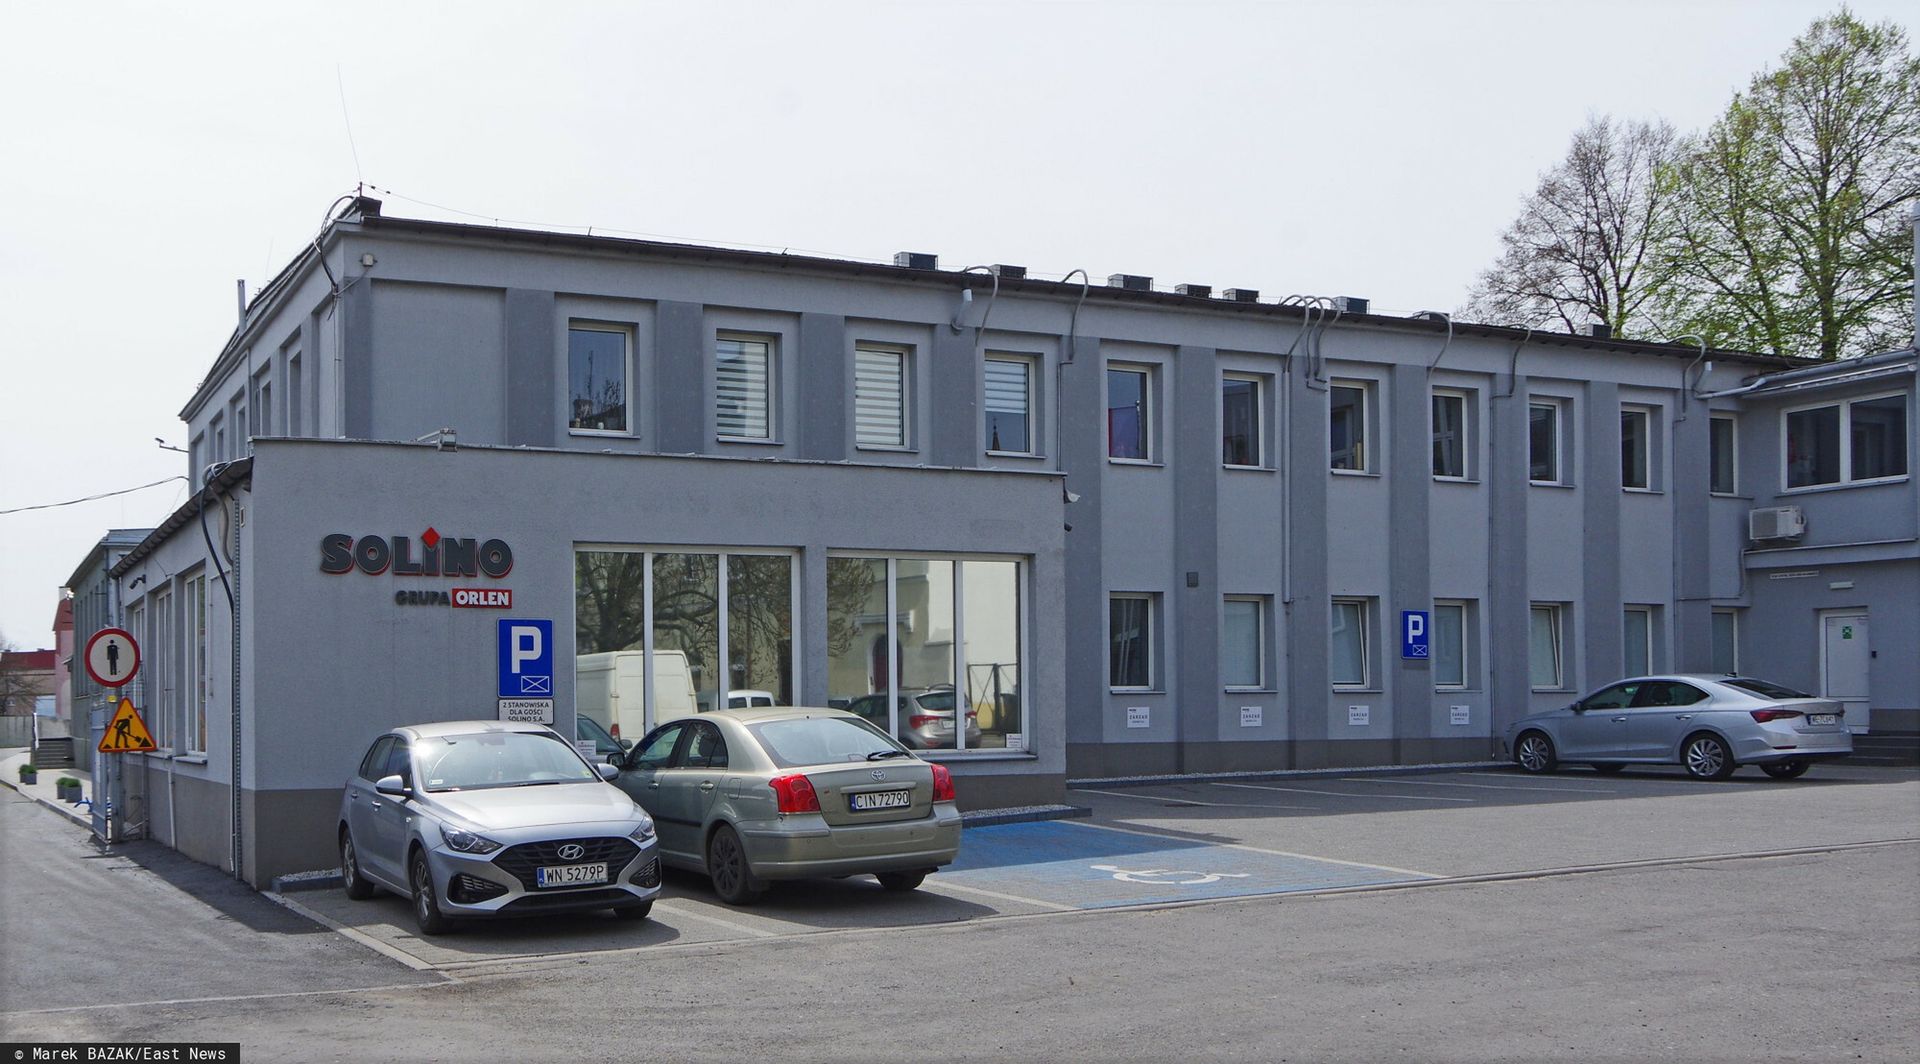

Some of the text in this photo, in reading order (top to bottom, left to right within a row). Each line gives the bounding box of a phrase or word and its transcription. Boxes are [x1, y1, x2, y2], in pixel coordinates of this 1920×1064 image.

[395, 590, 510, 606] GRUPA ORLEN
[1408, 614, 1424, 644] P
[511, 626, 542, 674] P
[523, 708, 543, 716] GOŚCI
[856, 791, 908, 808] CIN 72790
[546, 865, 604, 882] WN 5279P
